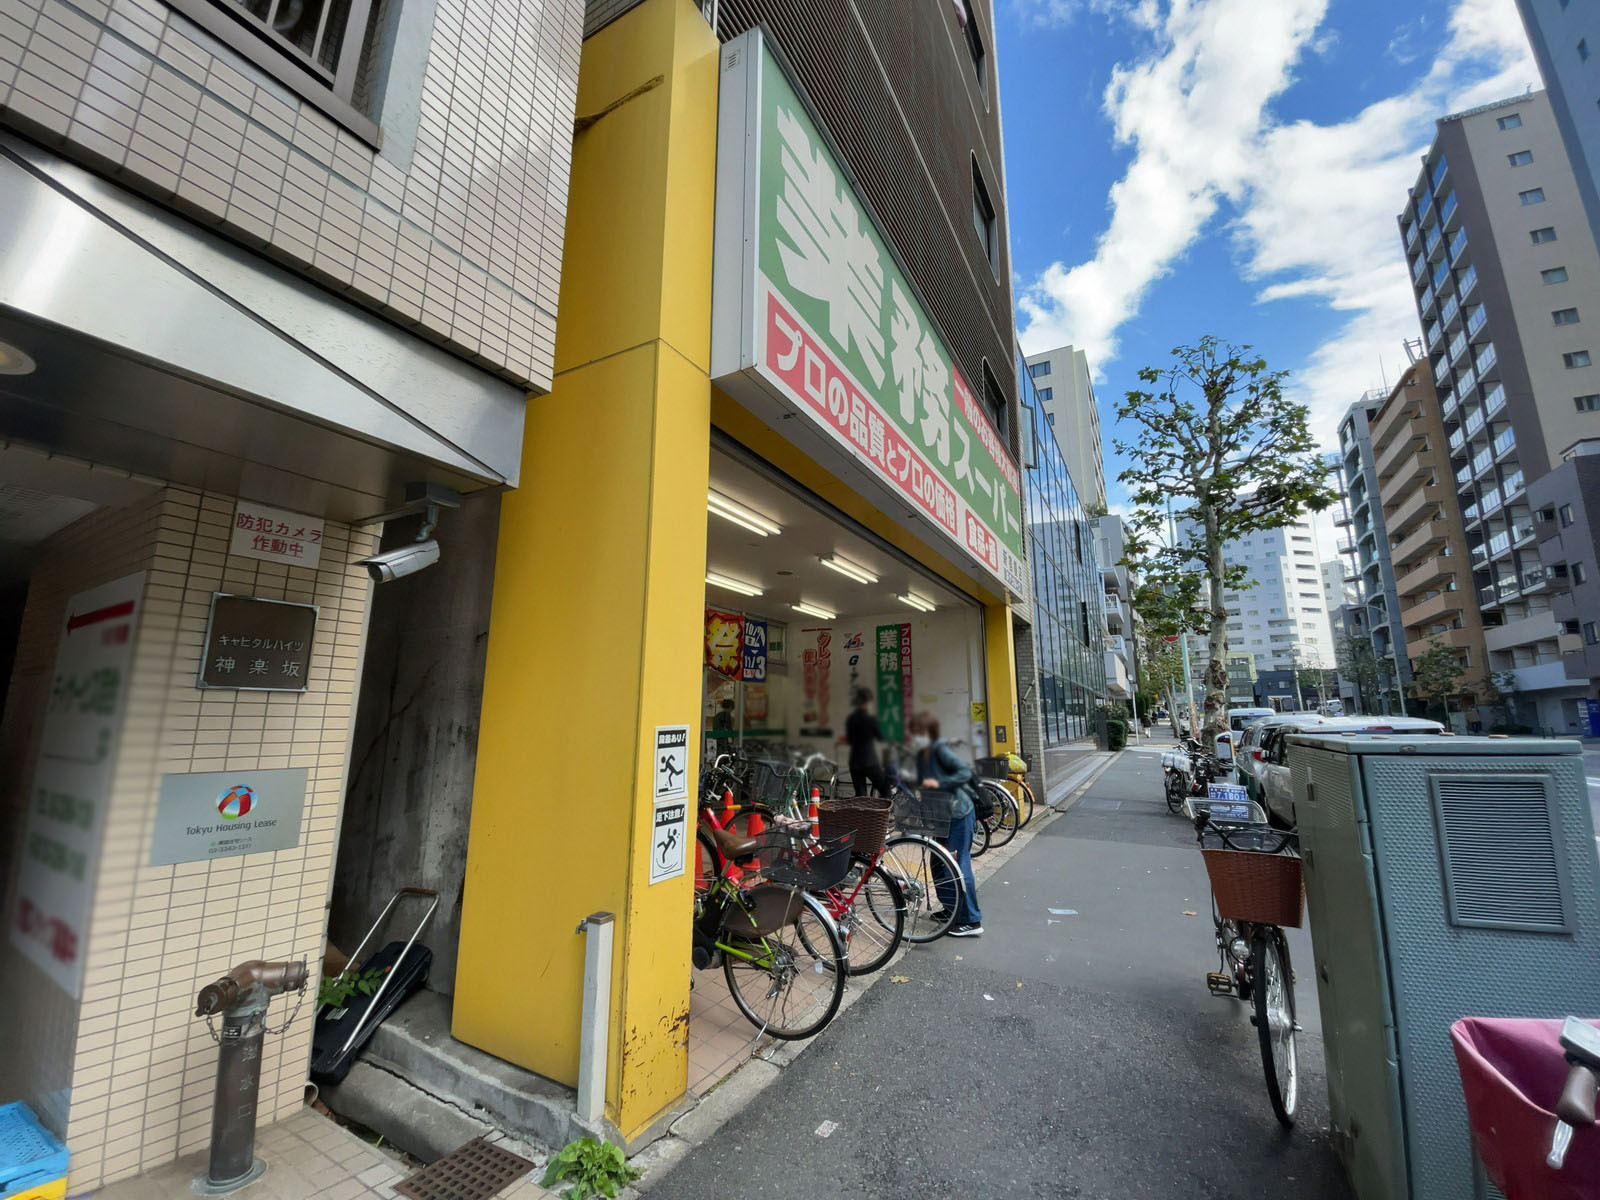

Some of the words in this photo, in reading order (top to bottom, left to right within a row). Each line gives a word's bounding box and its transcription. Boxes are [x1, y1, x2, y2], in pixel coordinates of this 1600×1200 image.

[776, 105, 1020, 535] 業務スーパー
[775, 312, 955, 531] プロの品質とプロの価格
[236, 512, 322, 542] 防犯カメラ
[251, 535, 304, 557] 作動中
[215, 656, 302, 677] 神楽坂
[879, 629, 899, 738] 業務スーパー
[186, 826, 213, 836] Tokyu
[215, 821, 251, 832] Housing
[254, 819, 278, 828] Lease
